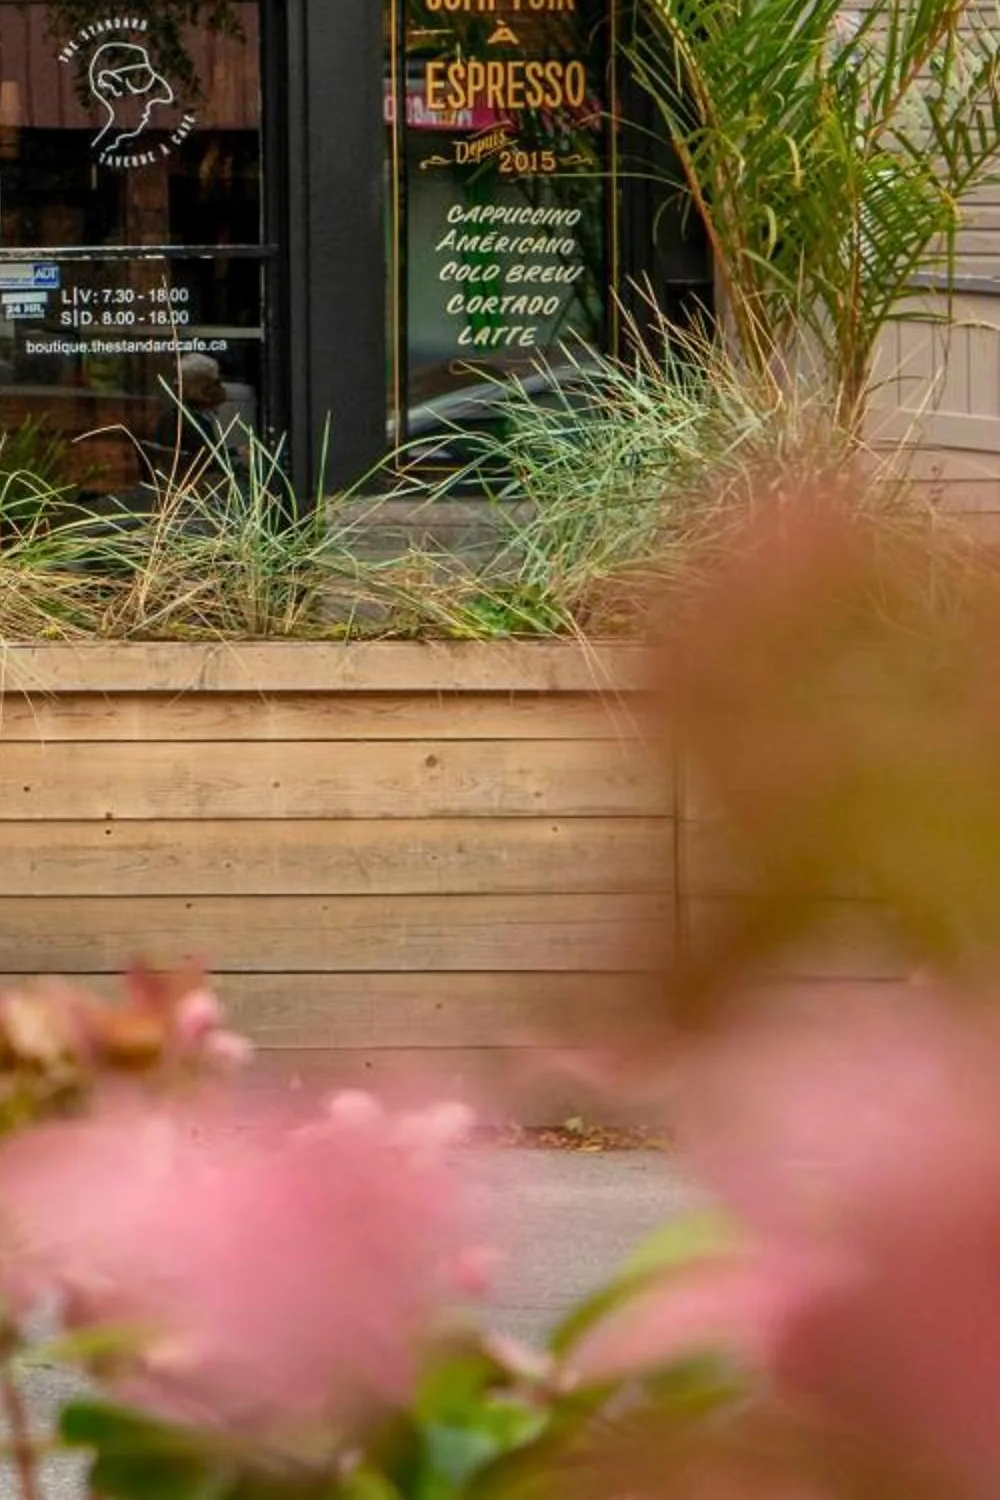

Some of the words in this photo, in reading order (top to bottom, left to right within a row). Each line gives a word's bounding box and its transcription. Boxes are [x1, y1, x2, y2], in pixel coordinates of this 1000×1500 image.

[488, 19, 519, 44] À
[58, 41, 79, 63] THE
[426, 61, 585, 110] ESPRESSO
[499, 151, 556, 173] 2015
[447, 204, 581, 226] CAPPUCCINO
[434, 229, 575, 255] AMÉRICANO
[439, 261, 501, 283] COLD
[505, 264, 585, 283] BREW
[102, 289, 135, 303] 7.30
[446, 294, 560, 315] CORTADO
[102, 310, 135, 325] 8.00
[458, 326, 538, 347] LATTE
